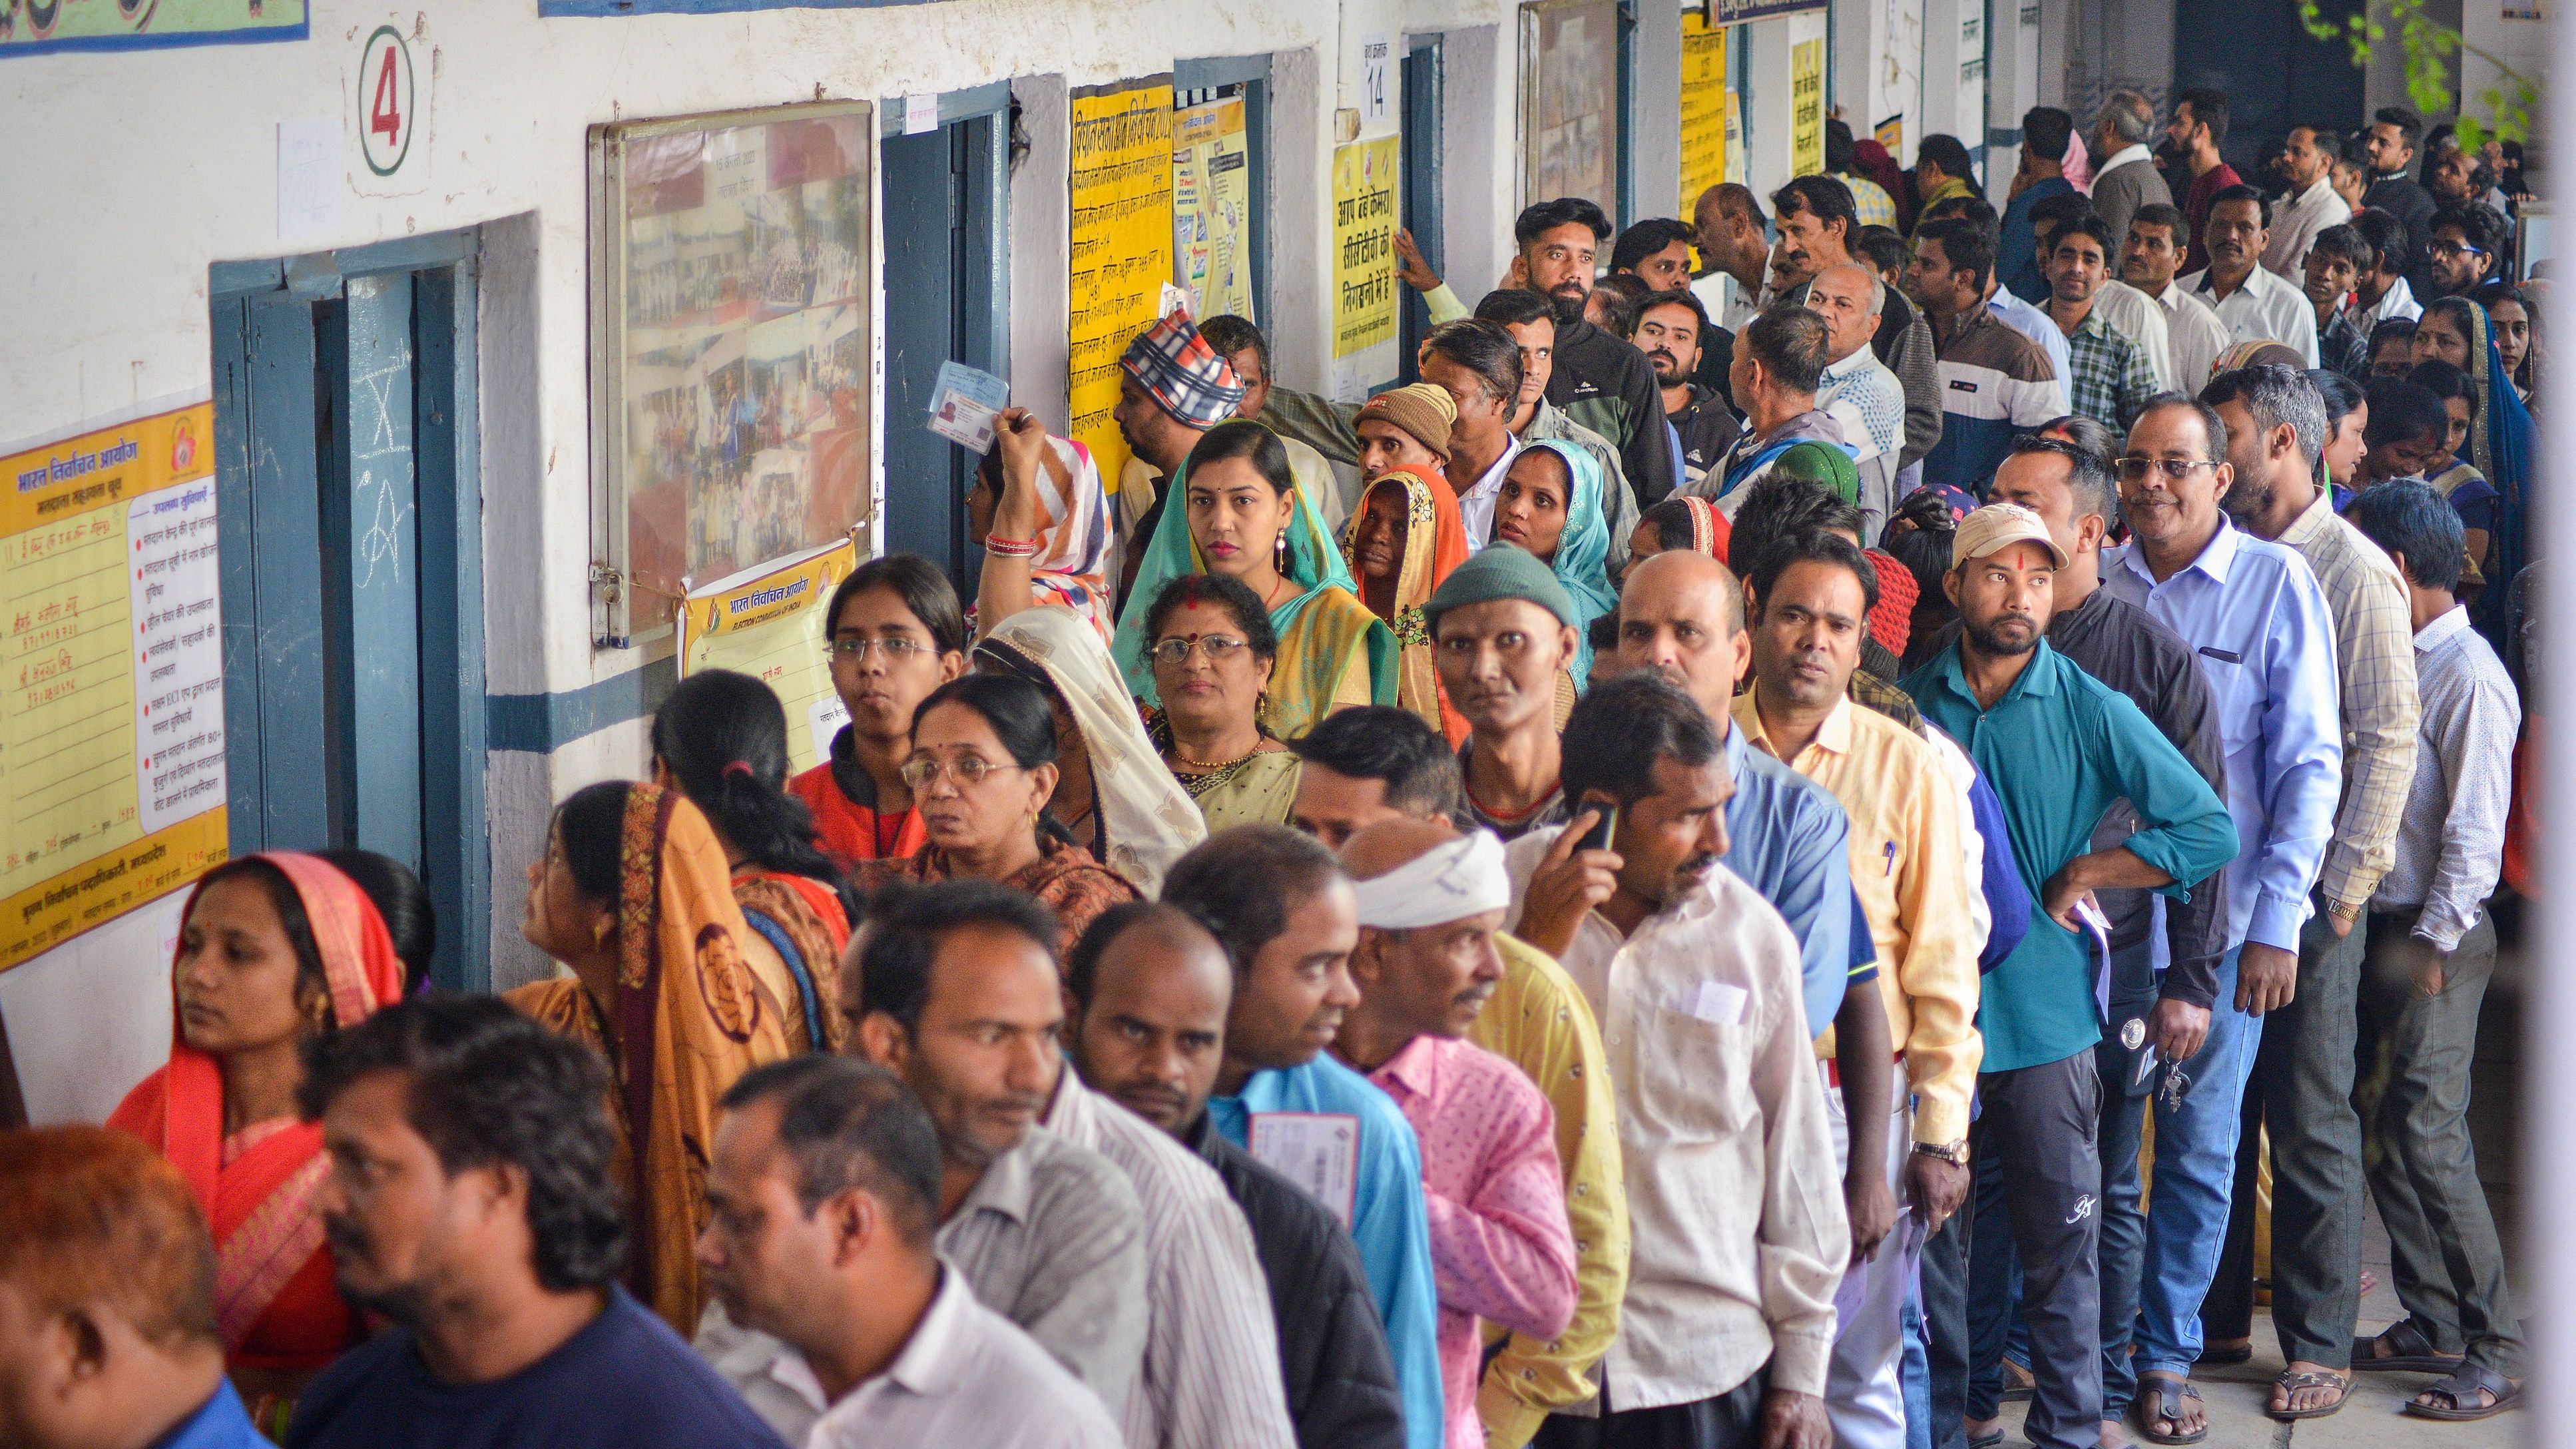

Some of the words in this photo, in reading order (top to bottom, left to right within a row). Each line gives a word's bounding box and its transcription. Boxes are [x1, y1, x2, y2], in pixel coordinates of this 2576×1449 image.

[372, 46, 399, 146] 4
[1368, 65, 1383, 117] 14
[1338, 198, 1355, 227] आप
[1380, 225, 1390, 258] की
[17, 468, 47, 492] भारत
[50, 449, 97, 485] निर्वाचन
[99, 437, 137, 469] आयोग
[179, 521, 188, 535] की
[729, 595, 750, 615] भारत
[750, 584, 785, 609] निर्वाचन
[785, 575, 810, 601] आयोग
[176, 603, 185, 619] की
[732, 617, 756, 631] ELECTION
[781, 605, 789, 615] OF
[206, 623, 215, 640] की
[167, 689, 180, 707] ECI
